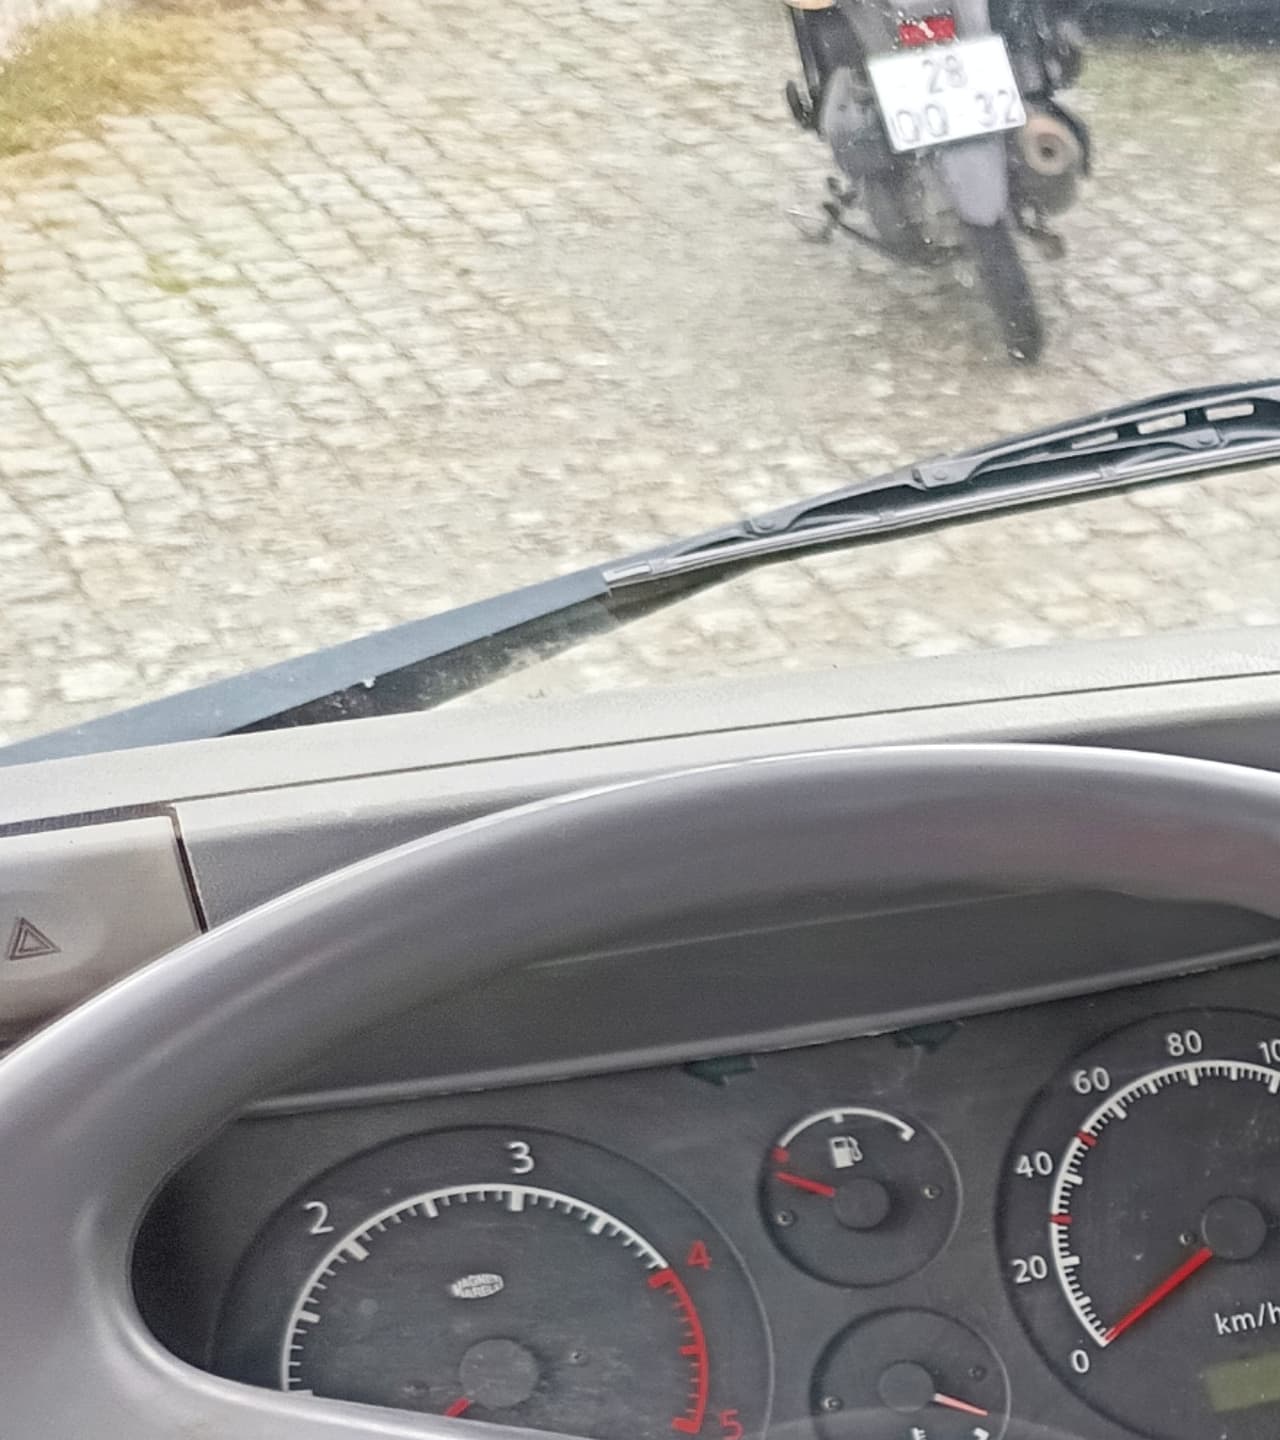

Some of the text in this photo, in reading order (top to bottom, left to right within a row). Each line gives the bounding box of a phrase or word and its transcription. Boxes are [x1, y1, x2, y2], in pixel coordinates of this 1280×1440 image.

[1167, 1030, 1203, 1057] 80
[1073, 1067, 1111, 1095] 60
[507, 1140, 536, 1174] 3
[1015, 1151, 1054, 1180] 40
[303, 1202, 334, 1235] 2
[688, 1240, 713, 1270] 4
[1013, 1256, 1049, 1284] 20
[1070, 1350, 1091, 1375] 0
